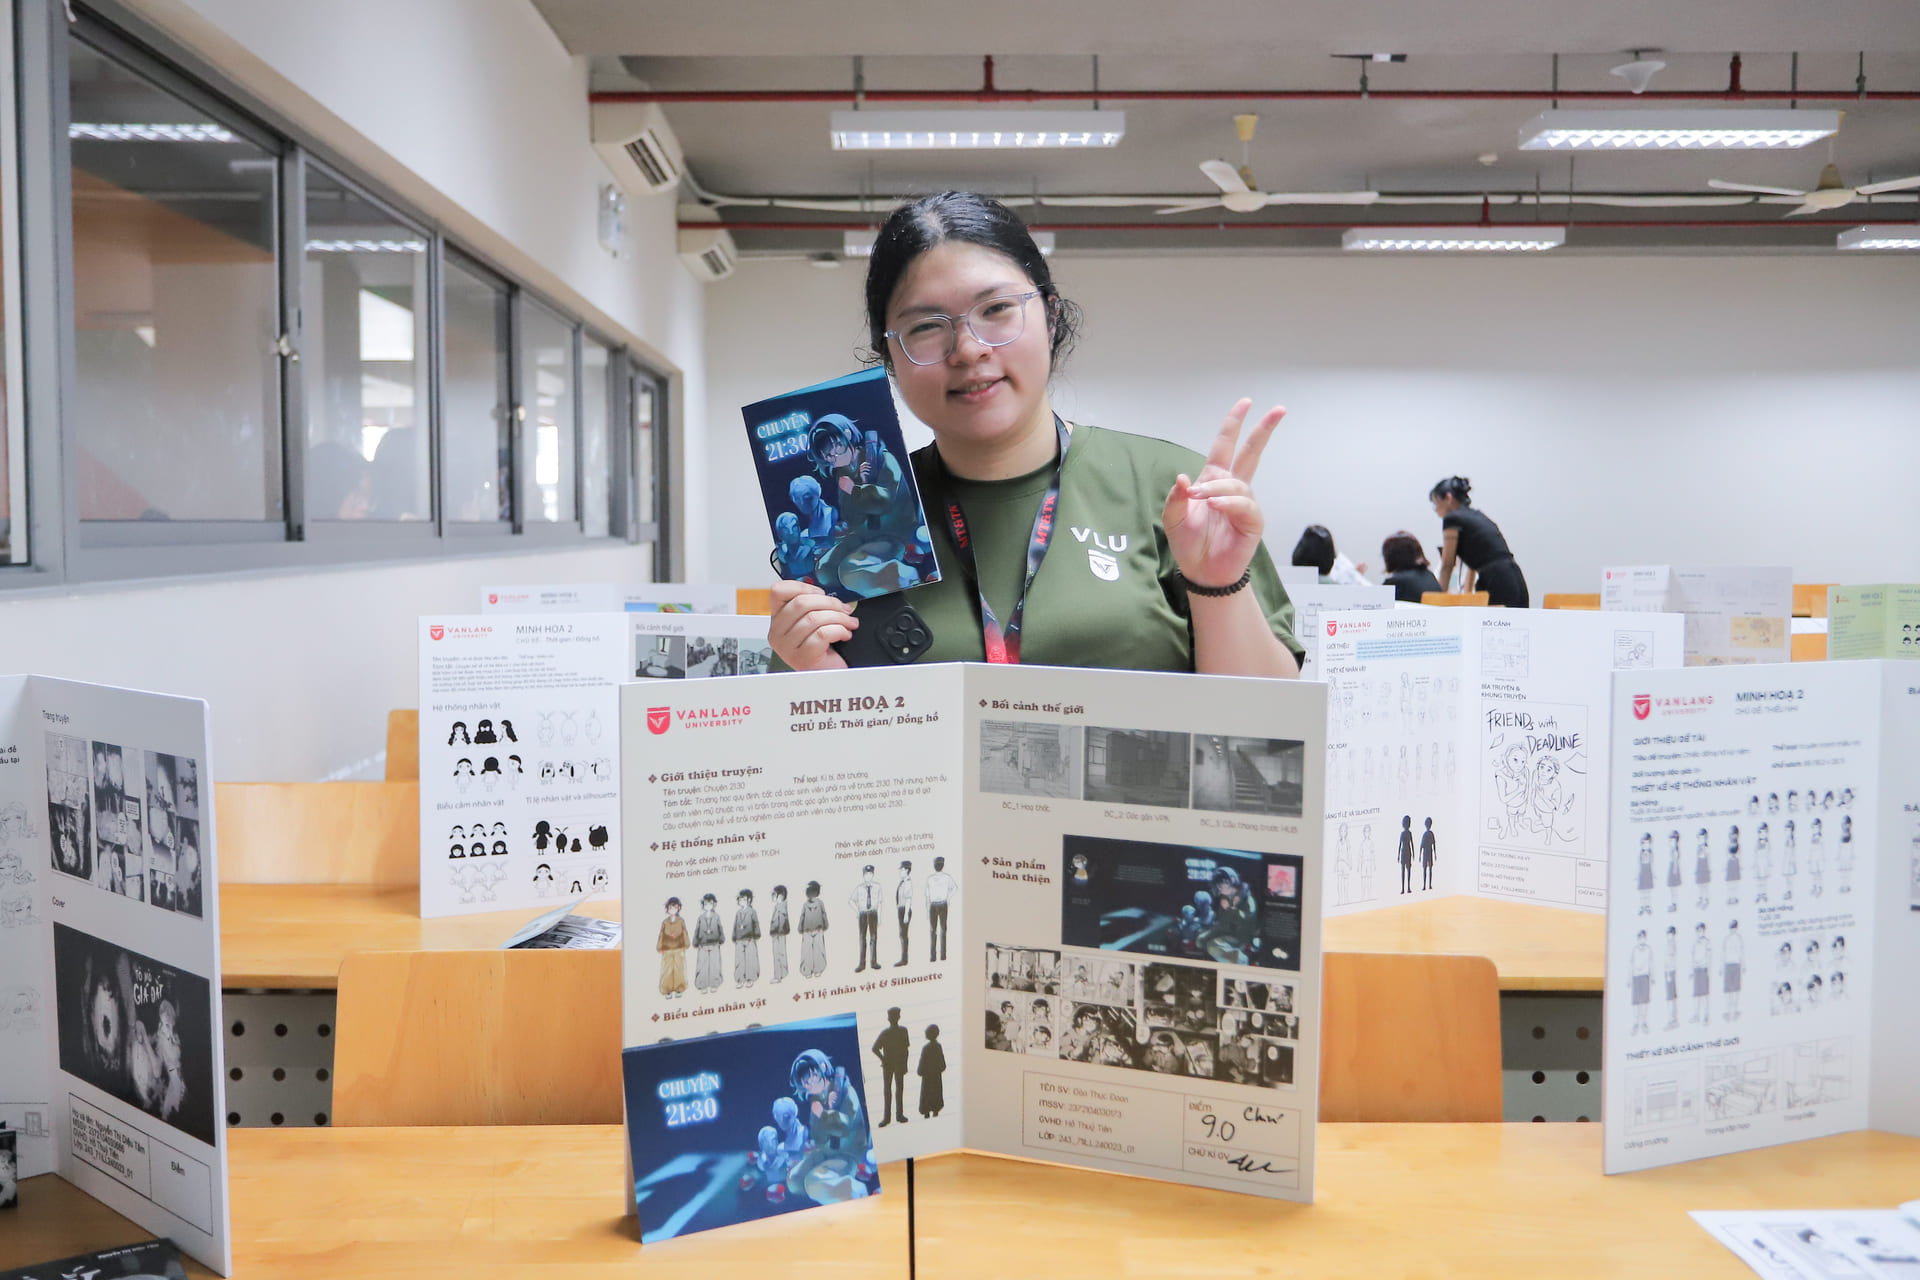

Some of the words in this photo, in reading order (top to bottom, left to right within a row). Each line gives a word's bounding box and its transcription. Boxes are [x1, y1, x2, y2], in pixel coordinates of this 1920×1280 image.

[756, 410, 810, 438] CHUYỆN
[765, 434, 810, 462] 21:30
[1071, 527, 1127, 552] VLU
[515, 625, 541, 634] MINH
[567, 623, 573, 632] 2
[1339, 621, 1371, 629] VANLANG
[1655, 696, 1713, 706] VANLANG
[1736, 691, 1767, 701] MINH
[1797, 689, 1804, 699] 2
[676, 706, 752, 720] VANLANG
[789, 698, 842, 715] MINH
[847, 694, 889, 714] HOẠ
[894, 695, 904, 708] 2
[991, 698, 1009, 709] Bối
[1012, 700, 1039, 711] cảnh
[1041, 701, 1062, 712] thế
[1063, 703, 1085, 715] giới
[685, 719, 743, 729] UNIVERSITY
[790, 718, 815, 732] CHỦ
[839, 717, 864, 728] Thời
[1538, 715, 1558, 730] with
[1526, 733, 1584, 757] DEADLINE
[660, 771, 685, 782] Giới
[687, 768, 718, 781] thiệu
[721, 764, 763, 778] truyện:
[661, 839, 677, 852] Hệ
[680, 834, 713, 850] thống
[717, 831, 745, 844] nhân
[748, 830, 766, 843] vật
[992, 855, 1011, 867] Sản
[1015, 856, 1046, 871] phẩm
[992, 869, 1019, 881] hoàn
[1022, 872, 1051, 885] thiện
[818, 987, 827, 999] lệ
[830, 983, 856, 996] nhân
[859, 980, 876, 993] vật
[890, 969, 943, 987] Silhouette
[663, 1006, 688, 1021] Biểu
[691, 1003, 715, 1017] cảm
[717, 998, 746, 1012] nhân
[749, 996, 767, 1009] vật
[658, 1072, 721, 1099] CHUYỆN
[665, 1098, 718, 1126] 21:30
[1201, 1114, 1235, 1142] 9.0
